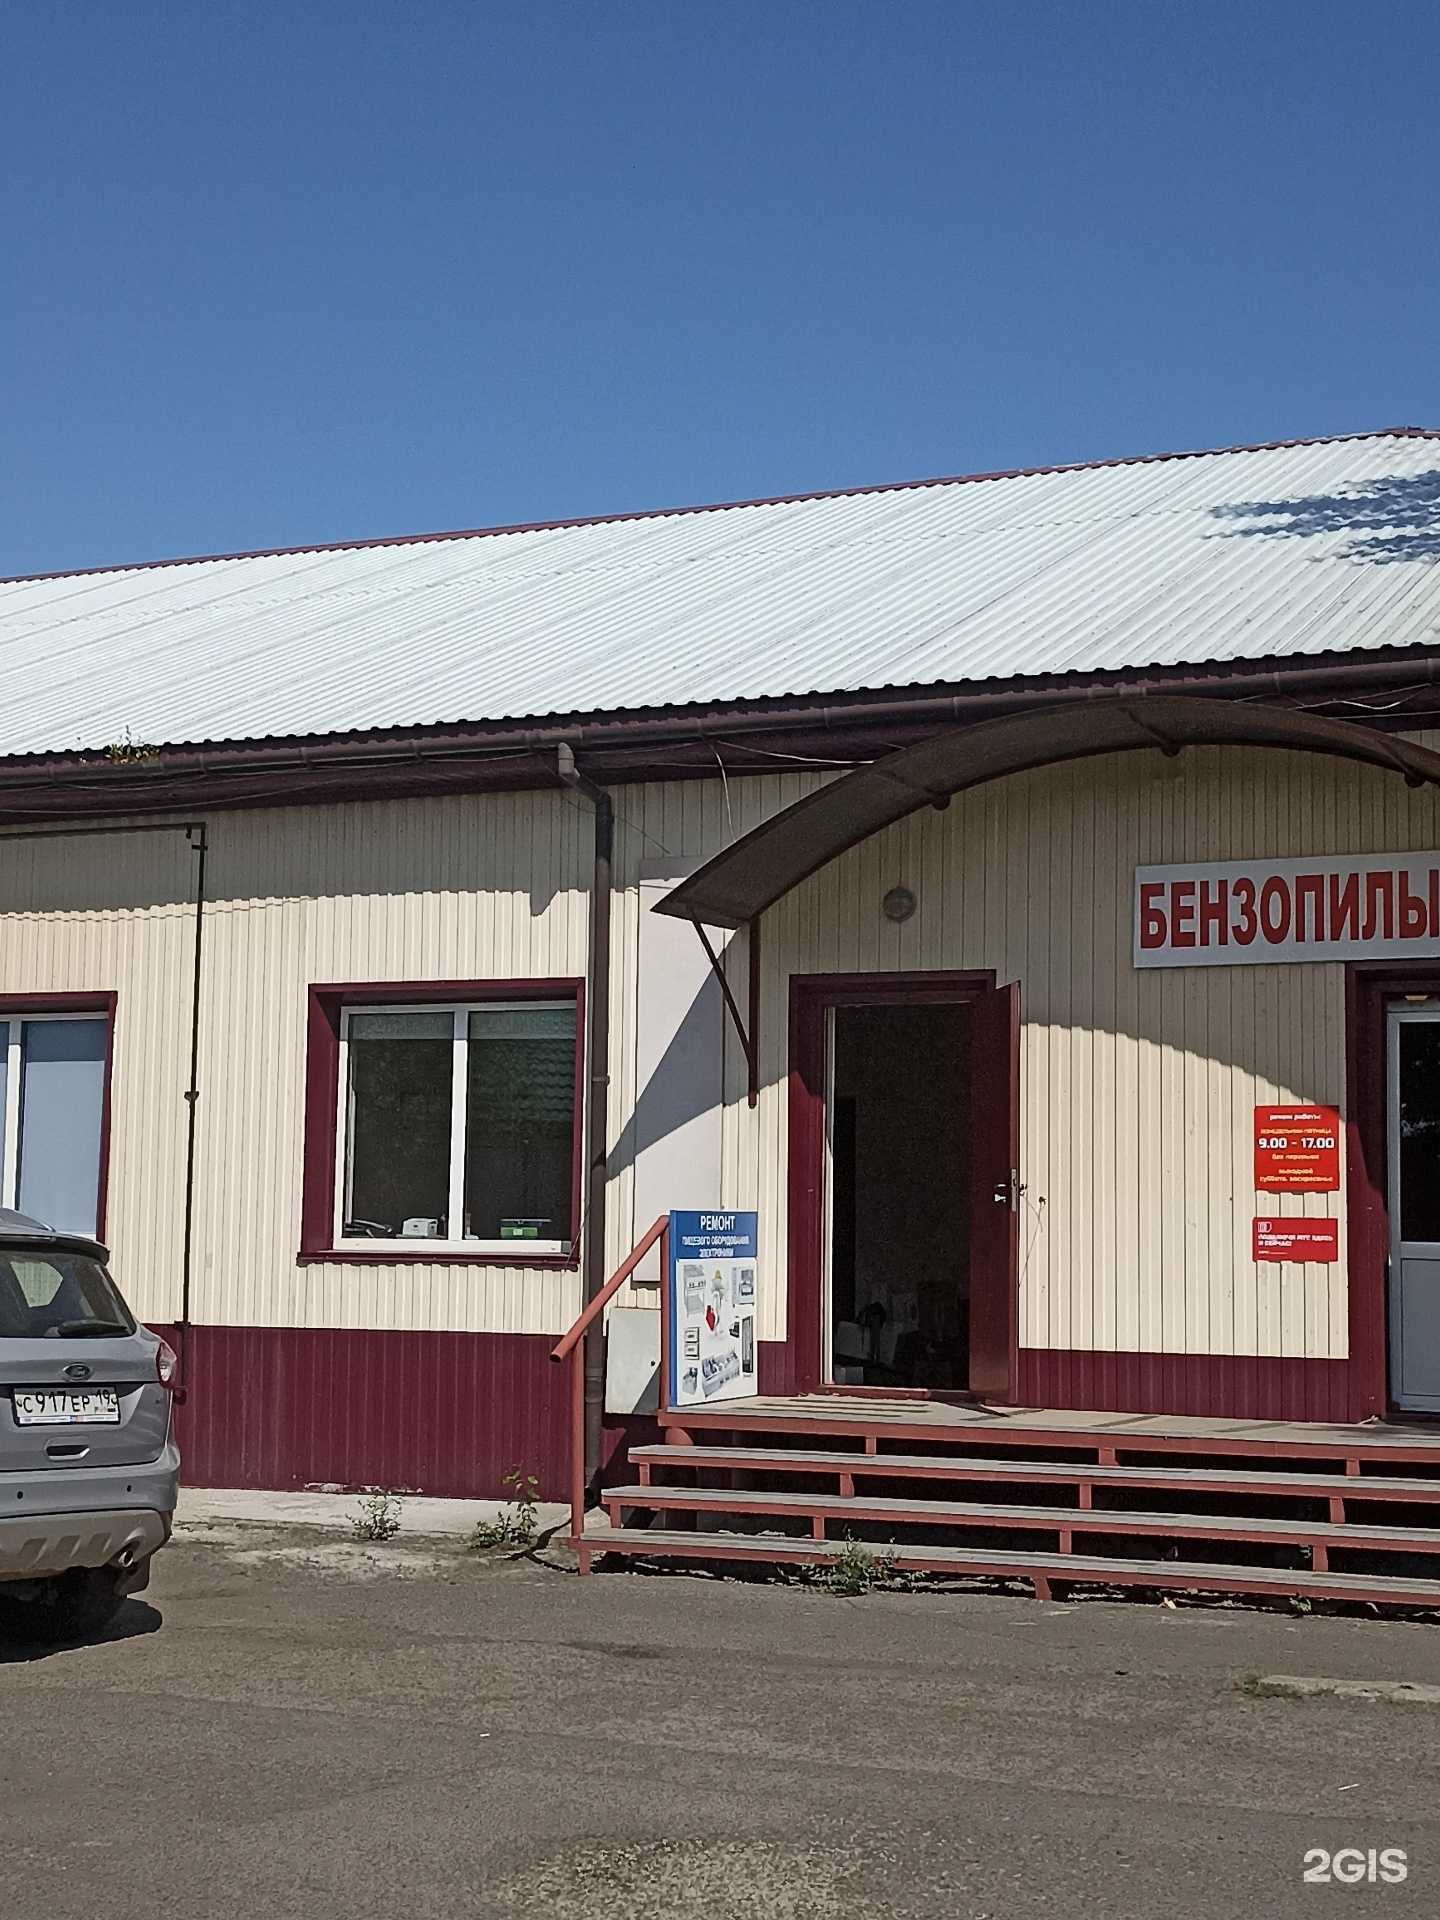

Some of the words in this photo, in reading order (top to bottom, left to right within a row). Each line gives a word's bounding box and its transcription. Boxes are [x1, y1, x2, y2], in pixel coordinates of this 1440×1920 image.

[1139, 868, 1440, 949] БЕНЗОПИЛЫ
[1258, 1137, 1288, 1149] 9.00
[1301, 1137, 1335, 1149] 17.00
[700, 1215, 736, 1231] РЕМОНТ
